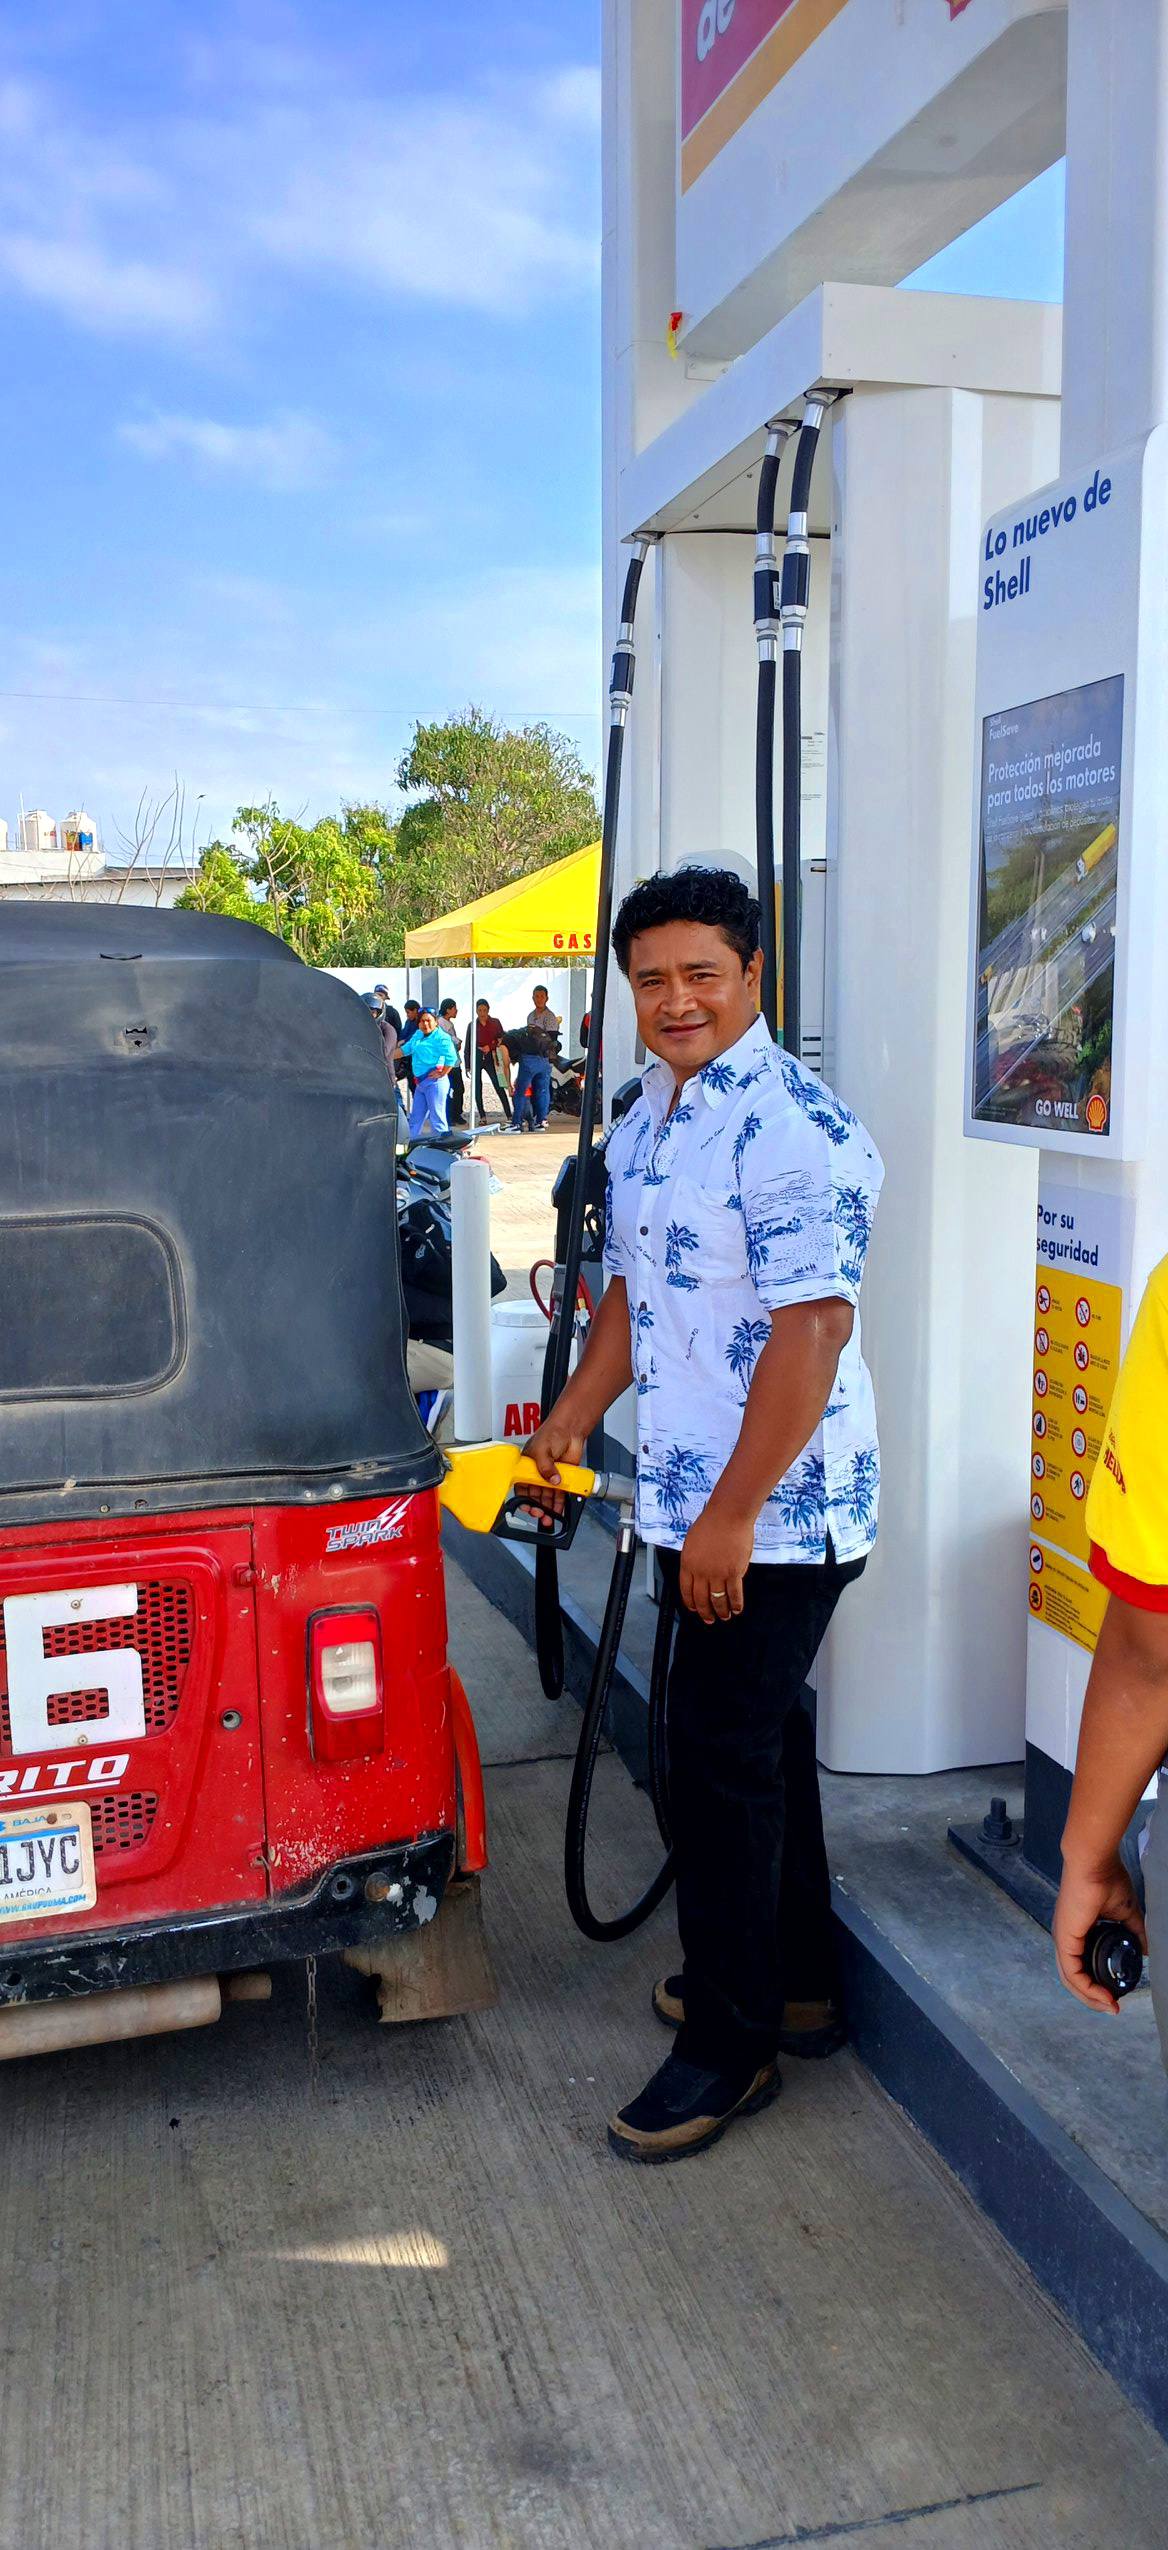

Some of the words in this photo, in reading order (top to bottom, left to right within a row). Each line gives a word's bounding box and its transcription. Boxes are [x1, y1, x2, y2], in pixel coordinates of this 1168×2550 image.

[985, 528, 1007, 561] Lo
[1013, 496, 1077, 548] nuevo
[1083, 469, 1111, 512] de
[983, 556, 1031, 610] Shell
[989, 724, 1019, 740] FuelSave
[988, 752, 1041, 783] Protección
[1044, 733, 1101, 772] mejorada
[987, 790, 1011, 815] para
[1014, 776, 1043, 802] todos
[1046, 771, 1063, 794] los
[1065, 765, 1116, 790] motores
[553, 933, 592, 949] GAS
[1035, 1099, 1052, 1116] GO
[1054, 1101, 1079, 1120] WELL
[1037, 1204, 1057, 1226] Por
[1060, 1214, 1075, 1230] su
[1037, 1238, 1099, 1266] seguridad
[325, 1525, 405, 1552] SPARK
[326, 1518, 382, 1540] TWIN
[3, 1582, 147, 1756] 6
[13, 1815, 50, 1828] BAJA
[0, 1834, 80, 1885] 1JYC
